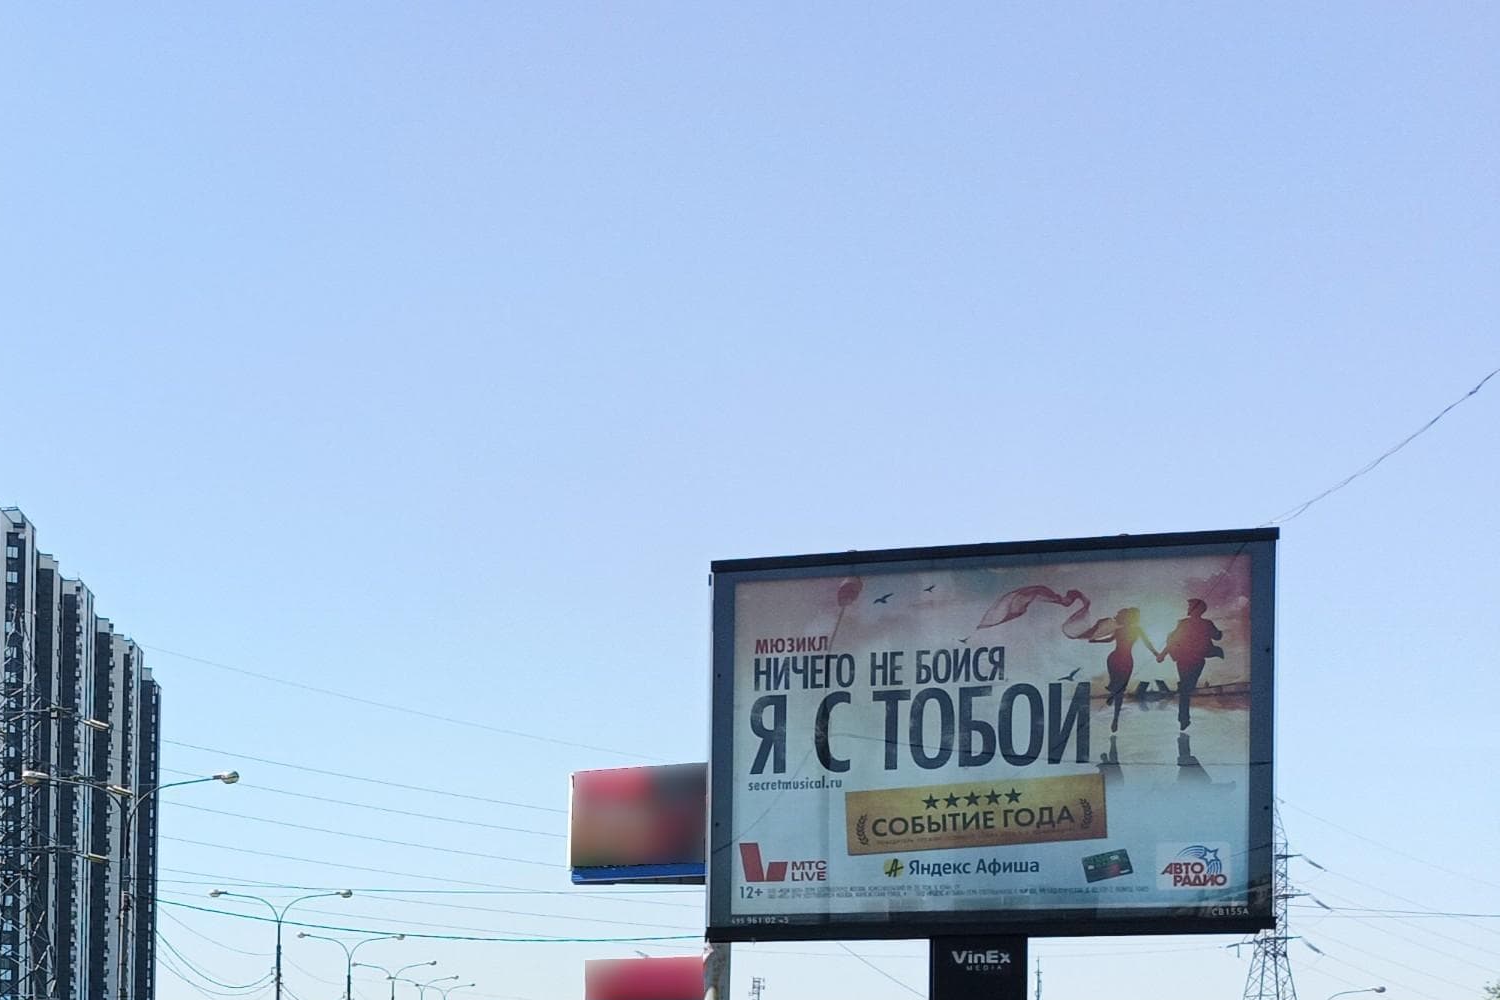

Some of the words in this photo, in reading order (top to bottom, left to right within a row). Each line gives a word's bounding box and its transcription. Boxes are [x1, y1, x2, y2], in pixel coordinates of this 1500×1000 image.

[754, 636, 828, 655] МЮЗИКЛ
[754, 652, 856, 691] НИЧЕГО
[870, 650, 905, 687] НЕ
[750, 695, 787, 774] Я
[814, 691, 851, 774] С
[748, 777, 842, 792] secretmusical.ru
[871, 810, 996, 838] СОБЫТИЕ
[1003, 805, 1076, 829] ГОДА
[791, 860, 827, 871] МТС
[908, 859, 971, 877] Яндекс
[975, 858, 1040, 876] Афиша
[1162, 862, 1205, 875] АВТО
[791, 871, 827, 882] LIVE
[1173, 873, 1227, 887] РАДИО
[739, 886, 763, 899] 12+
[951, 950, 1011, 964] VinEx
